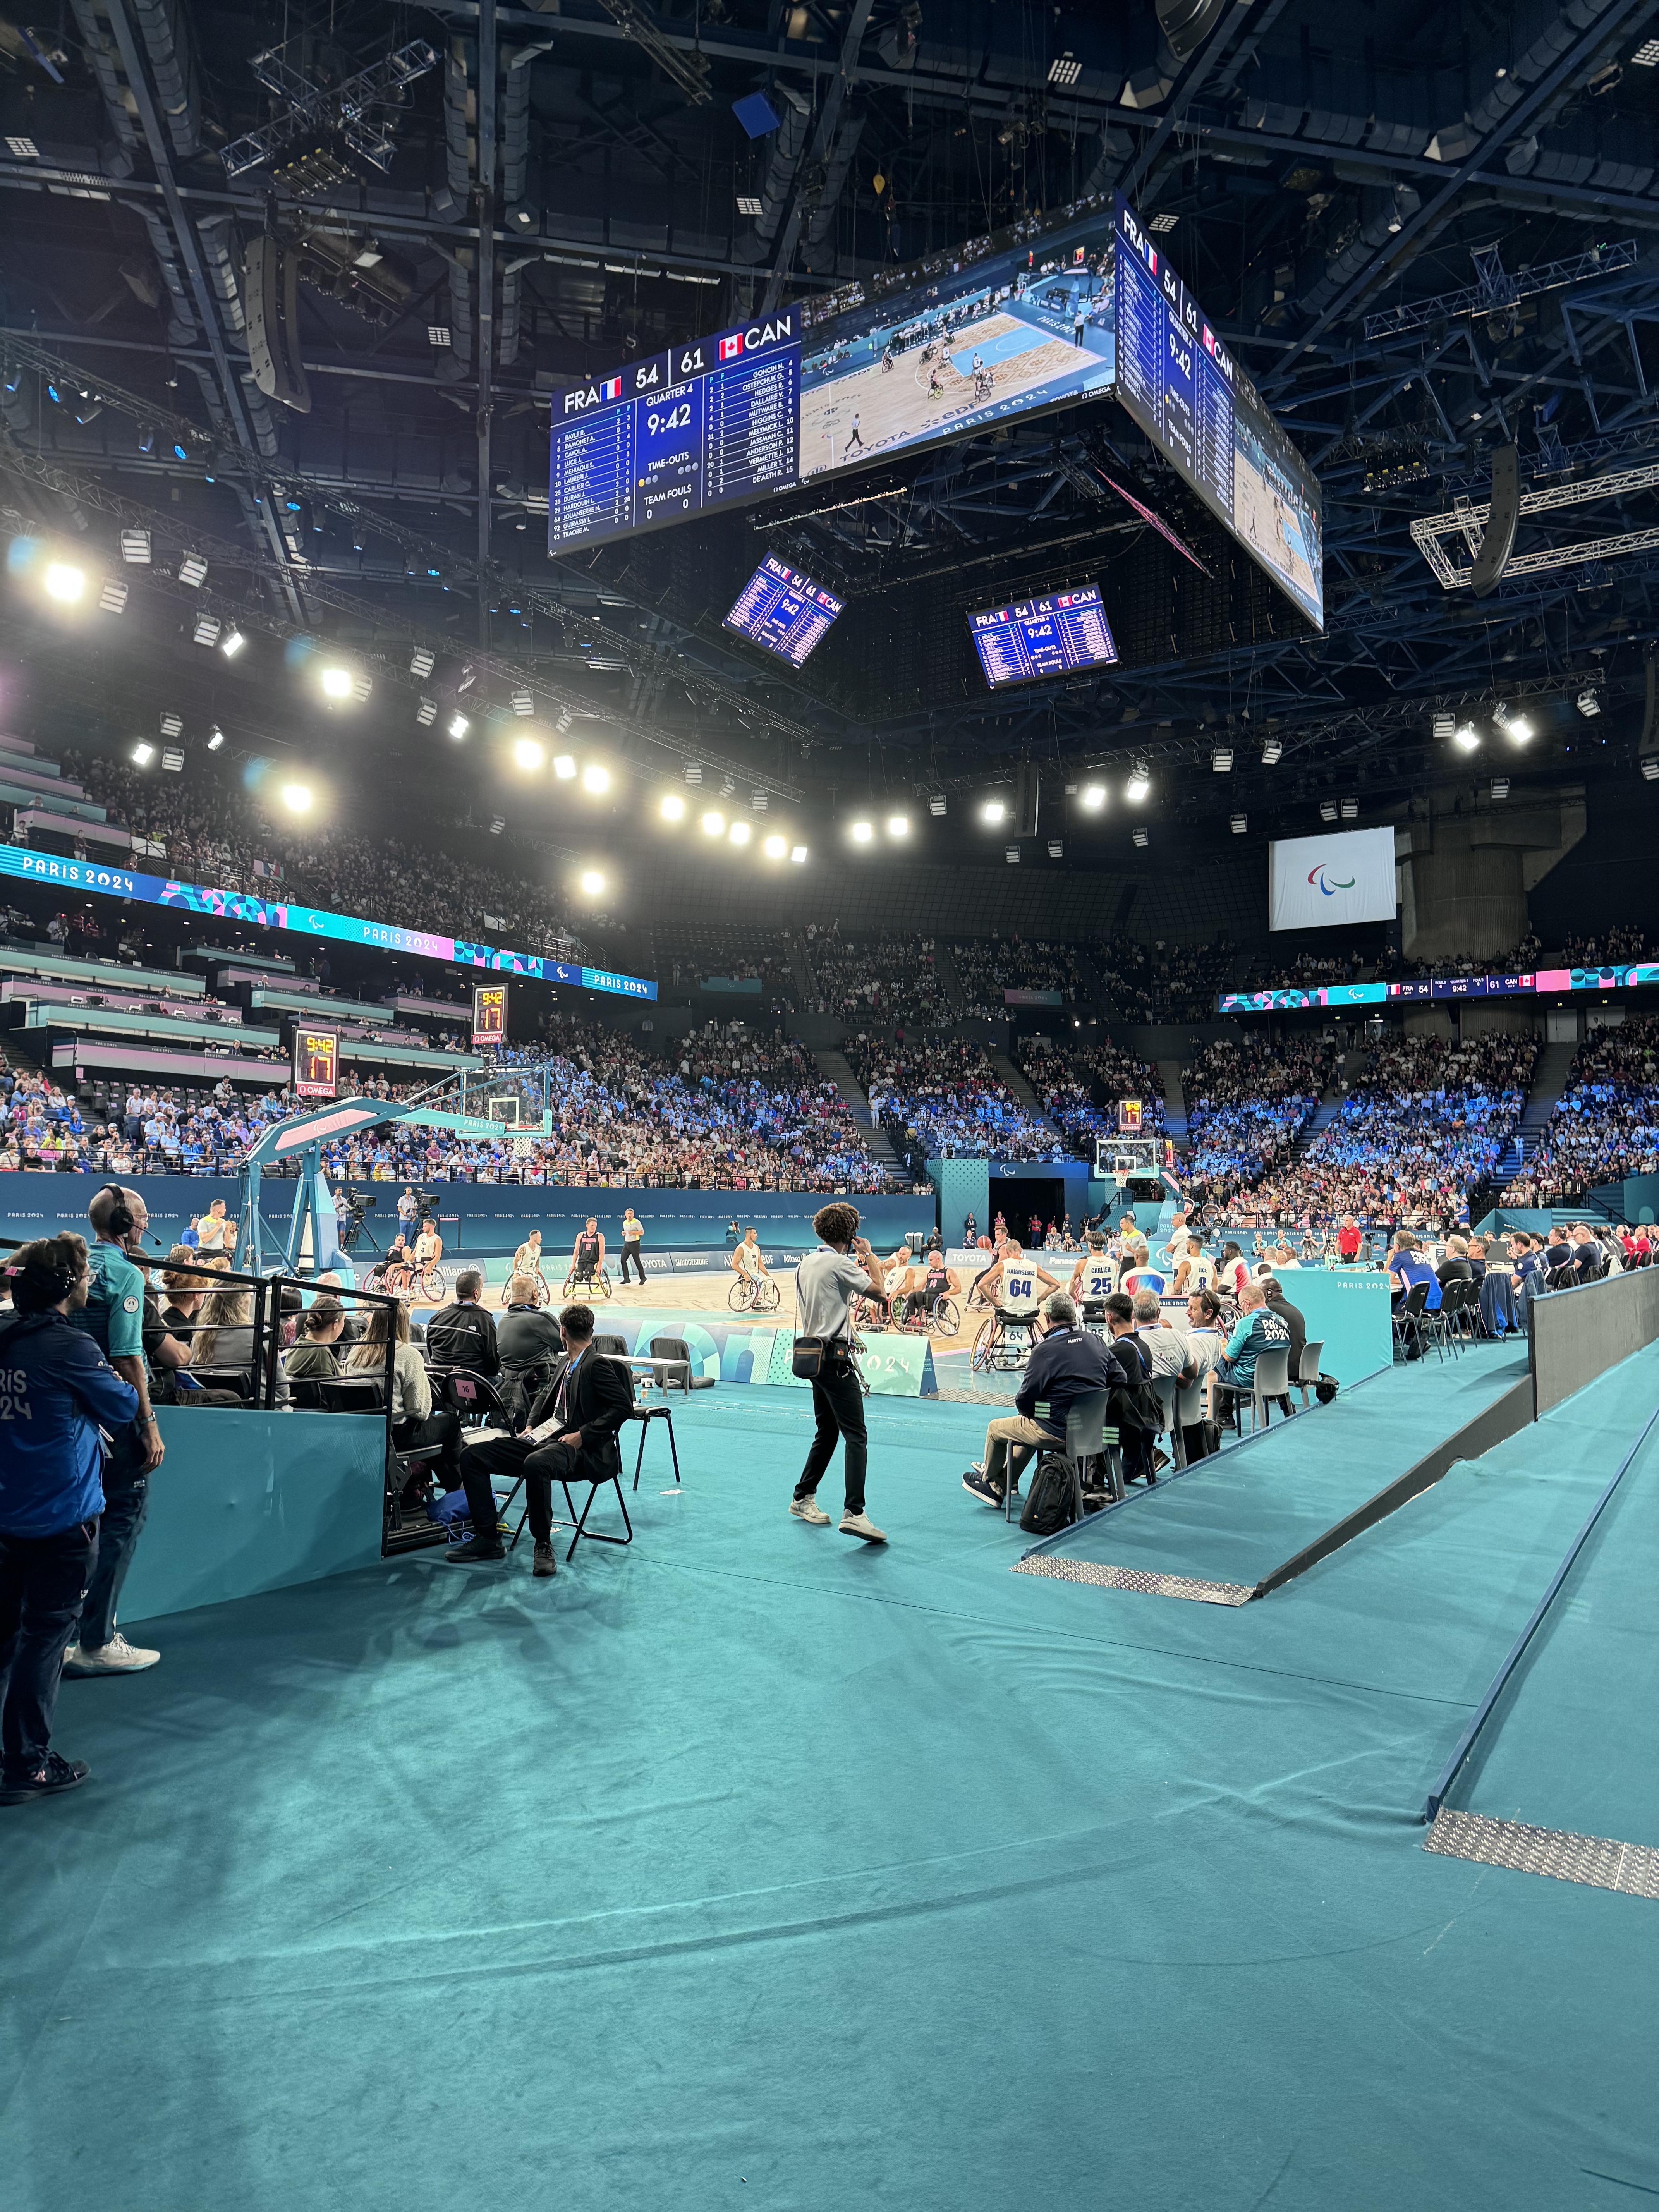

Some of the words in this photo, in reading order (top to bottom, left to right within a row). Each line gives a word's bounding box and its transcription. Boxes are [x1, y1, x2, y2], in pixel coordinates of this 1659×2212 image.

[1124, 210, 1145, 259] FRA
[1164, 269, 1176, 301] 54
[1187, 302, 1197, 332] 61
[744, 316, 790, 349] CAN
[1169, 311, 1188, 344] QUARTER
[681, 348, 704, 373] 61
[1169, 334, 1190, 380] 9:42
[1214, 342, 1233, 381] CAN
[635, 364, 658, 389] 54
[753, 364, 776, 378] GONCIN
[742, 374, 776, 391] OSTEPCHUK
[646, 387, 686, 407] QUARTER
[687, 384, 693, 393] 4
[755, 384, 777, 396] HEDGES
[1088, 386, 1111, 397] OMEGA
[565, 387, 600, 413] FRA
[751, 393, 777, 407] DALLAIRE
[1000, 390, 1048, 411] 2024
[1170, 384, 1190, 416] TIME-OUTS
[748, 403, 777, 417] MUTWARE
[647, 403, 690, 436] 9:42
[752, 413, 776, 426] HIGGINS
[748, 422, 777, 437] MELYMICK
[565, 432, 580, 441] BAYLE
[750, 433, 776, 446] JASSMAN
[1168, 419, 1178, 437] TEAM
[1178, 433, 1191, 454] FOULS
[565, 438, 589, 449] RAMONET
[746, 442, 777, 457] ANDERSON
[840, 431, 910, 462] TOYOTA
[565, 449, 581, 458] CAYOL
[749, 452, 777, 465] VERMETTE
[648, 452, 689, 471] TIME-OUTS
[757, 461, 777, 473] MILLER
[564, 464, 589, 476] MEHIAOUI
[564, 474, 584, 484] LAURERI
[752, 471, 776, 483] DE'AETH
[564, 483, 583, 493] CARLIER
[778, 482, 796, 491] OMEGA
[564, 493, 581, 502] DURAN
[644, 492, 665, 505] TEAM
[667, 484, 692, 498] FOULS
[563, 500, 589, 511] HARDOUIN
[683, 499, 688, 508] 0
[563, 507, 594, 520] JOUANSERRE
[647, 510, 652, 519] 0
[563, 518, 587, 529] GUIRASSY
[563, 528, 582, 538] TRAORE
[766, 558, 781, 575] FRA
[792, 575, 803, 587] 54
[806, 585, 816, 597] 61
[1071, 591, 1096, 604] CAN
[781, 599, 799, 615] 9:42
[825, 598, 842, 613] CAN
[1015, 606, 1028, 617] 54
[1039, 601, 1052, 612] 61
[975, 614, 997, 627] FRA
[1027, 625, 1052, 638] 9:42
[86, 870, 133, 892] 2024
[405, 935, 438, 952] 2024
[623, 981, 647, 994] 2024
[1419, 985, 1428, 993] 54
[482, 991, 503, 1005] 9:42
[484, 1008, 501, 1029] 17
[307, 1037, 333, 1053] 9:42
[311, 1056, 331, 1080] 17
[307, 1087, 333, 1096] OMEGA
[486, 1123, 503, 1131] 2024
[643, 1259, 667, 1268] OYOTA
[783, 1255, 801, 1263] Allianz
[953, 1254, 986, 1262] TOYOTA
[1010, 1279, 1031, 1298] 64
[1091, 1278, 1111, 1295] 25
[1199, 1277, 1206, 1288] 8
[1009, 1331, 1024, 1341] 64
